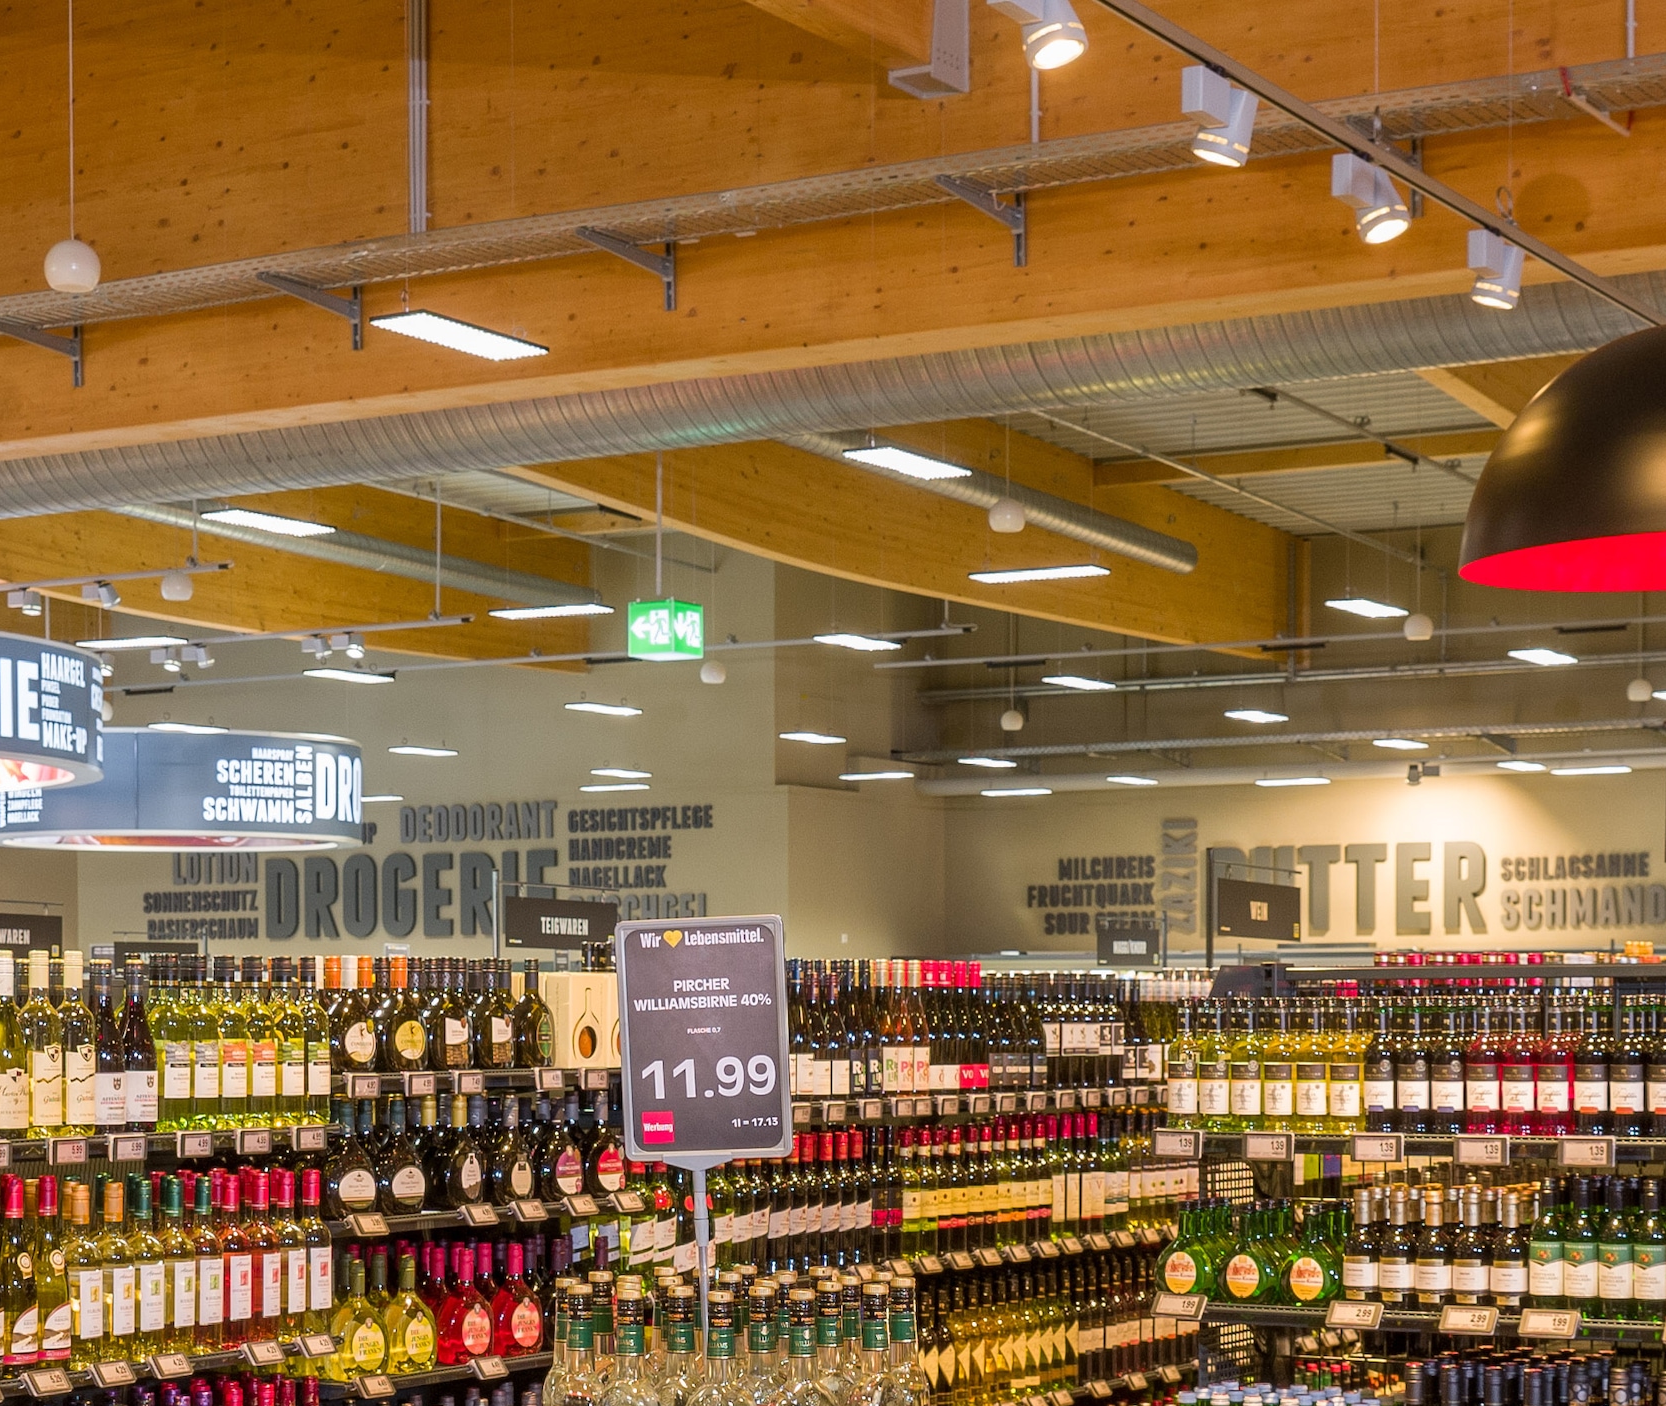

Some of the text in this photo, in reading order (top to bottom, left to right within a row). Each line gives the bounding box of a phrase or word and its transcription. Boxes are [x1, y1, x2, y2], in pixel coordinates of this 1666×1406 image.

[41, 652, 85, 688] HAARGEL
[42, 721, 87, 754] MAKE-UP
[217, 759, 294, 786] SCHEREN
[295, 746, 313, 824] SALBEN
[203, 797, 294, 823] SCHWAMM
[400, 801, 557, 843] DEODORANT
[567, 805, 713, 832] GESICHTSPFLEGE
[568, 836, 671, 861] HANDCREME
[173, 852, 257, 885] LOTION
[569, 864, 666, 889] NAGELLACK
[1058, 856, 1155, 881] MILCHREIS
[1501, 852, 1650, 881] SCHLAGSAHNE
[144, 890, 258, 913] SONNENSCHUTZ
[1027, 883, 1155, 908] FRUCHTQUARK
[148, 918, 258, 939] RASIERSCHAUM
[541, 917, 588, 936] TEIGWAREN
[1045, 913, 1089, 935] SOUR
[640, 928, 764, 948] Wir Lebensmittel.
[674, 978, 729, 992] PIRCHER
[634, 993, 771, 1011] WILLIAMSBIRNE 40%
[642, 1055, 776, 1099] 11.99
[643, 1122, 673, 1133] Werbung
[752, 1117, 778, 1126] 17.13
